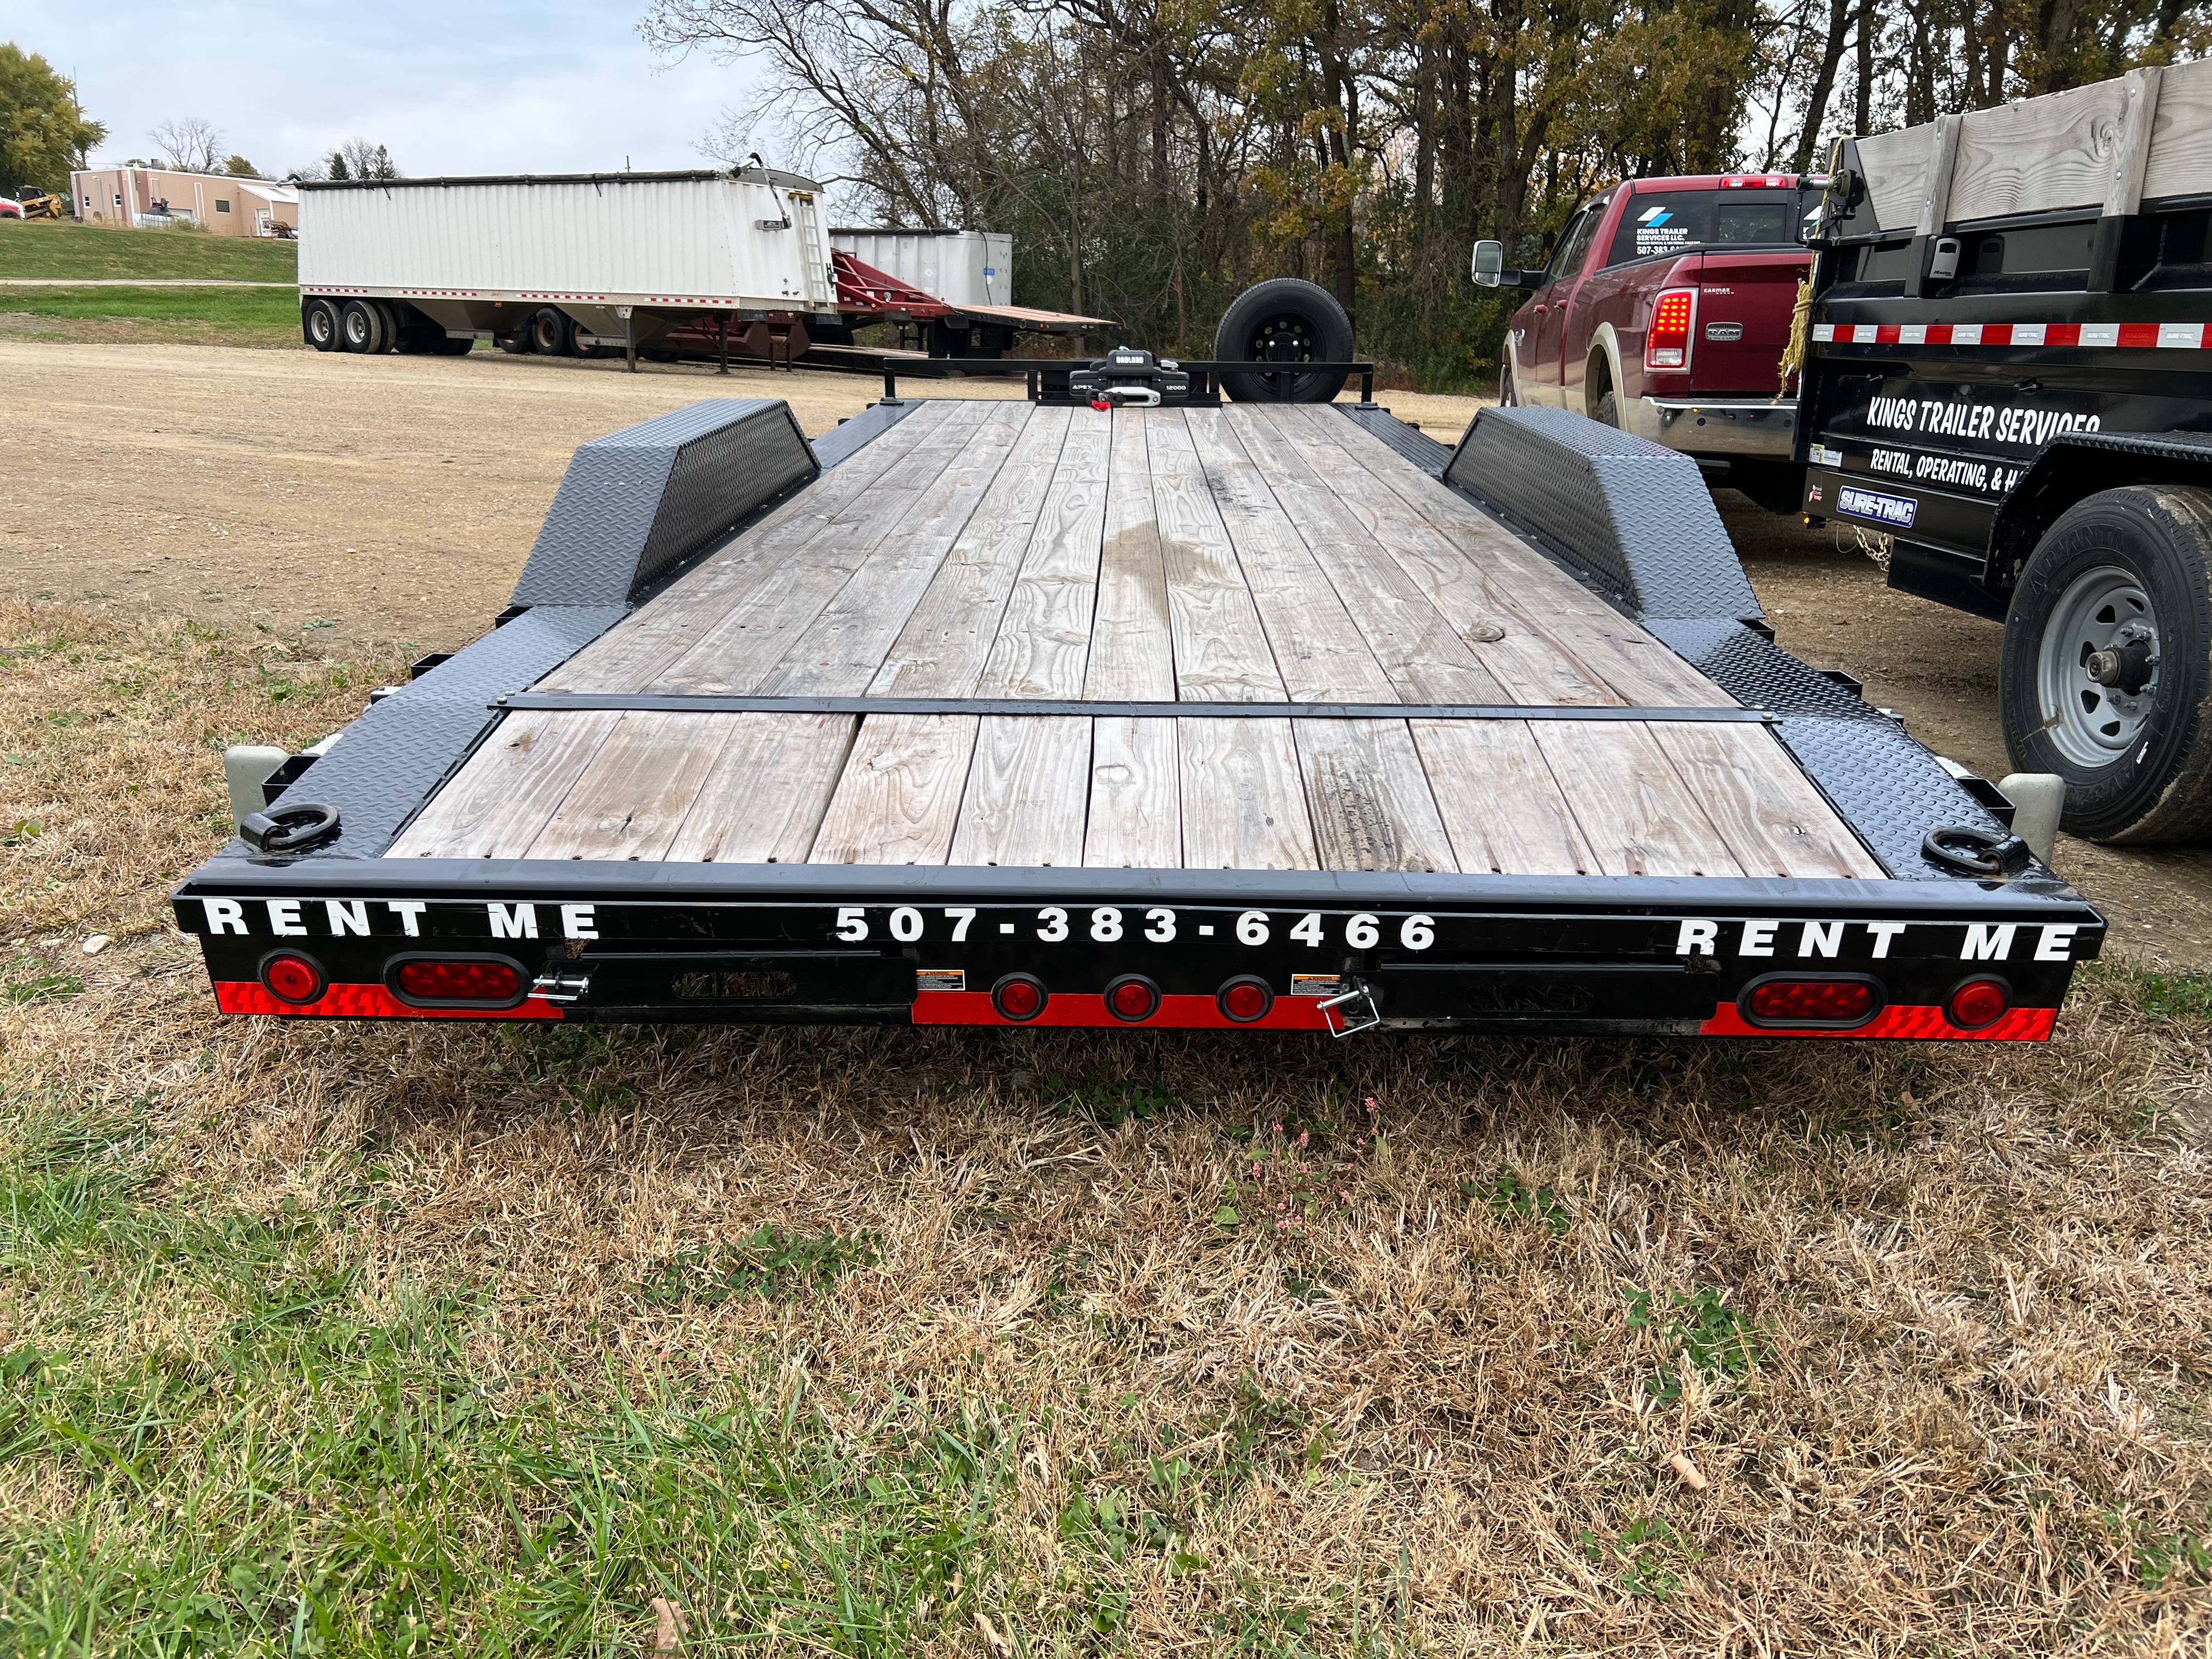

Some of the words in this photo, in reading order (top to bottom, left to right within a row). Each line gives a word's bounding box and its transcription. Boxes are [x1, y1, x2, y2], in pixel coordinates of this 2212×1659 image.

[1866, 396, 1917, 431] KINGS
[1918, 400, 1995, 439] TRAILER
[1870, 448, 1914, 478] RENTAL,
[1916, 455, 1988, 492] OPERATING,
[1991, 467, 2002, 491] &
[1839, 490, 1914, 523] SURE-TRAC
[202, 898, 427, 937] RENT
[487, 903, 600, 940] ME
[836, 907, 1435, 950] 507-383-6466
[1675, 919, 1905, 959] RENT
[1959, 924, 2078, 961] ME
